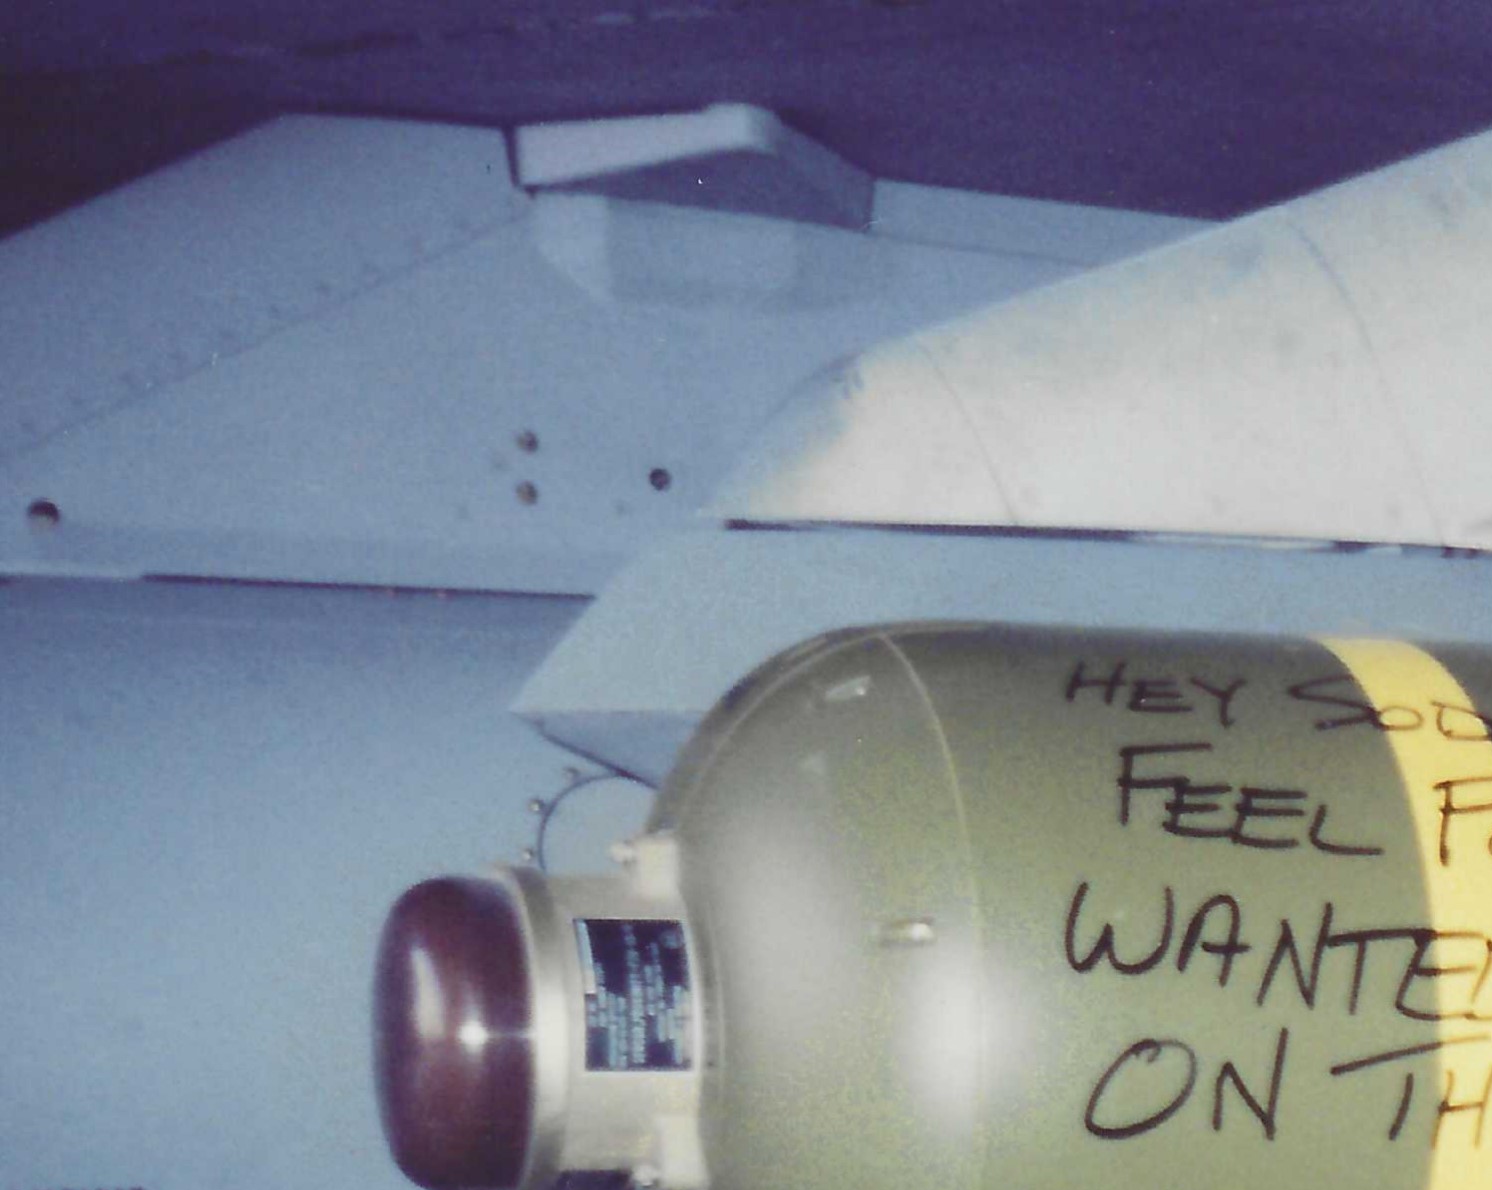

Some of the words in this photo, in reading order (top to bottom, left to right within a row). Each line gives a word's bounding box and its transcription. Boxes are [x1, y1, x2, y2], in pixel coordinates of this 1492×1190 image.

[1065, 662, 1242, 727] HEY
[1116, 743, 1383, 856] FEEL
[1084, 1028, 1289, 1140] ON
